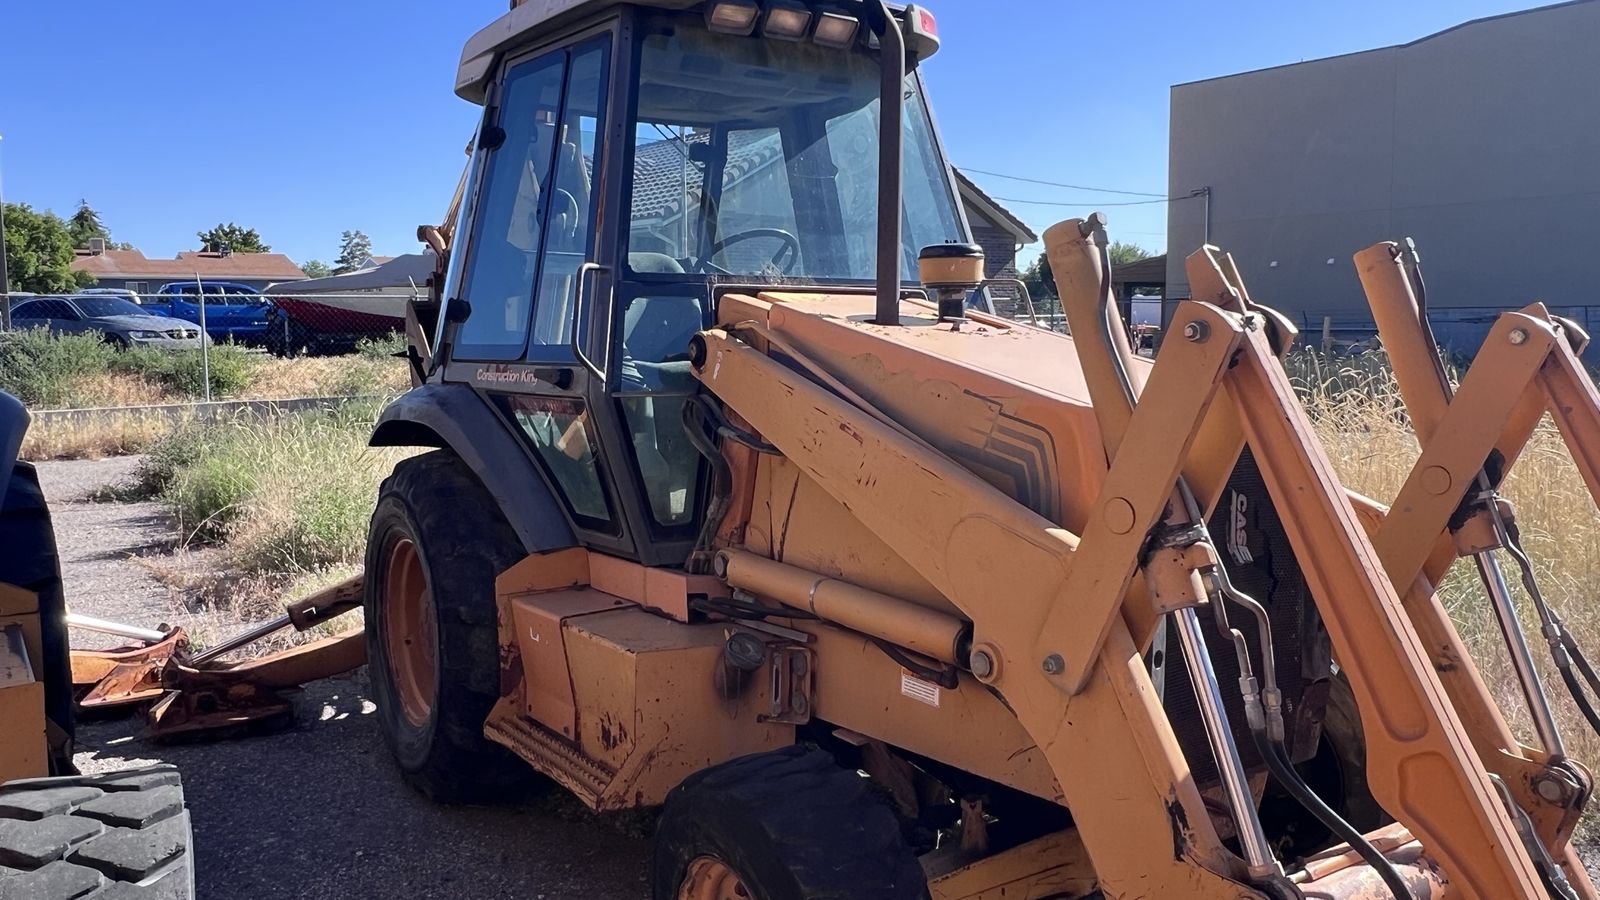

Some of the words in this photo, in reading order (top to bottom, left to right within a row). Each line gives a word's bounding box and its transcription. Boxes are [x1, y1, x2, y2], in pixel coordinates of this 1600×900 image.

[476, 369, 520, 383] Construction
[521, 370, 538, 386] King
[1235, 493, 1254, 563] CASE
